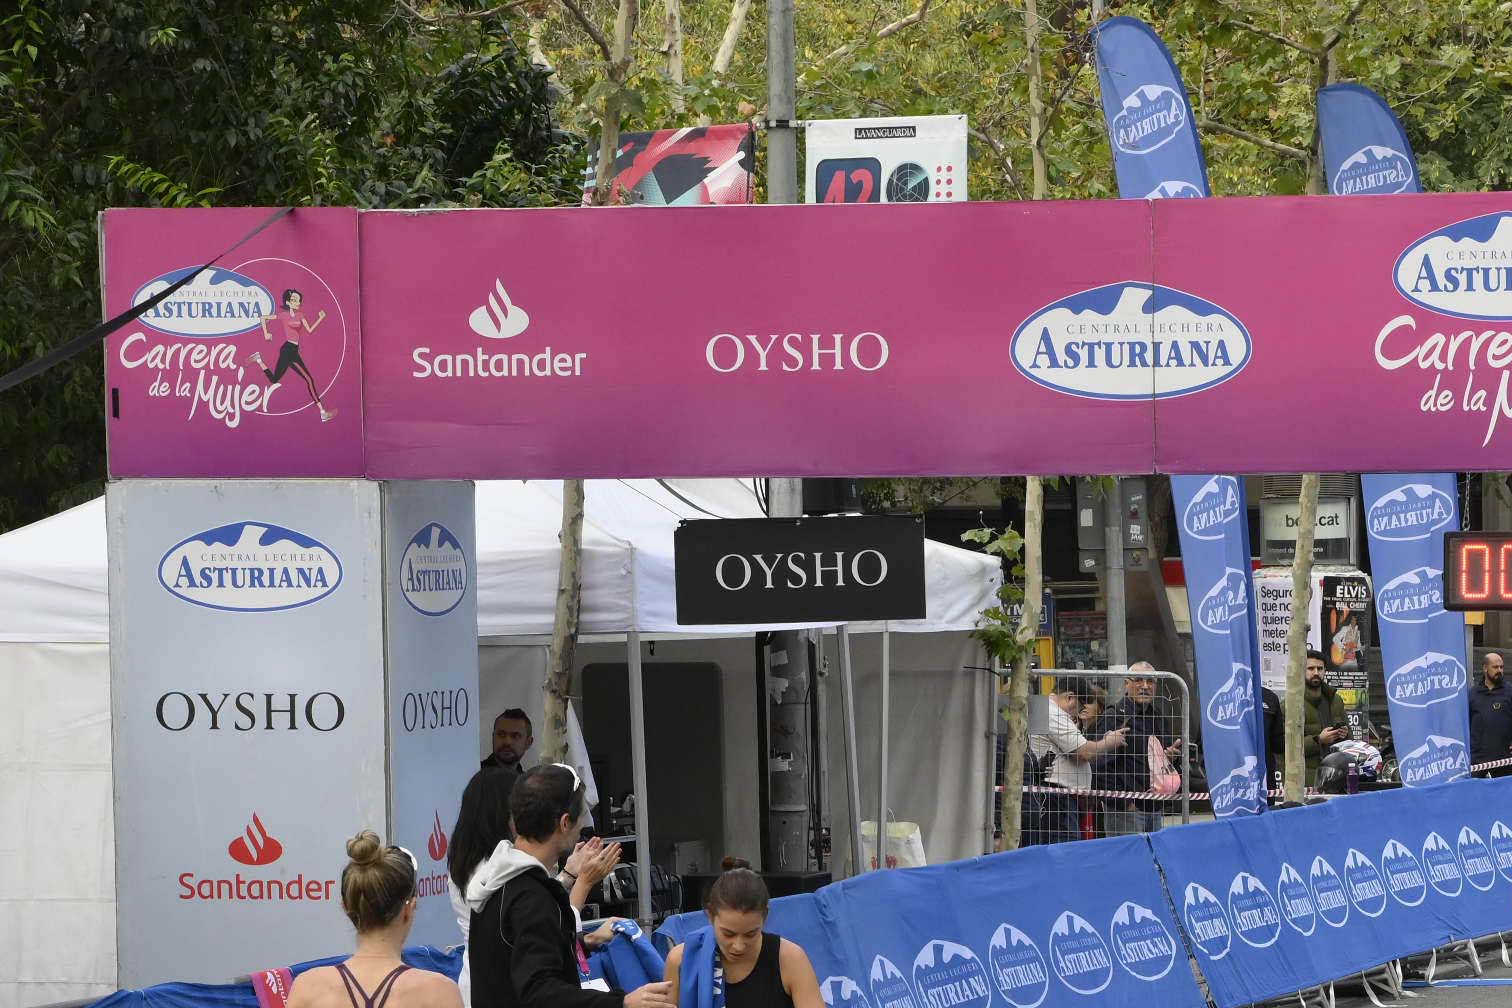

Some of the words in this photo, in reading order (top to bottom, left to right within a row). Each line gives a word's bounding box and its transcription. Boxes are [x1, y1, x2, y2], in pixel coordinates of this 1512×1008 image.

[1065, 322, 1141, 335] CENTRAL
[1148, 322, 1226, 335] LECHERA
[120, 332, 238, 369] Carrera
[412, 347, 587, 378] Santander
[706, 332, 889, 373] OYSHO
[1028, 326, 1233, 371] ASTURIANA
[149, 371, 173, 397] de
[176, 367, 191, 397] la
[187, 367, 281, 428] Mujer
[1421, 373, 1455, 412] de
[1462, 372, 1487, 412] la
[173, 555, 329, 590] ASTURIANA
[201, 552, 258, 562] CENTRAL
[264, 552, 323, 562] LECHERA
[715, 548, 888, 592] OYSHO
[405, 557, 463, 593] ASTURIANA
[1336, 586, 1366, 598] ELVIS
[1262, 602, 1278, 615] que
[1262, 613, 1294, 627] quiere
[1263, 642, 1281, 653] este
[155, 691, 346, 732] OYSHO
[403, 687, 470, 732] OYSHO
[179, 872, 336, 901] Santander
[994, 957, 1046, 992] ASTURIANA
[1055, 944, 1110, 977] ASTURIANA
